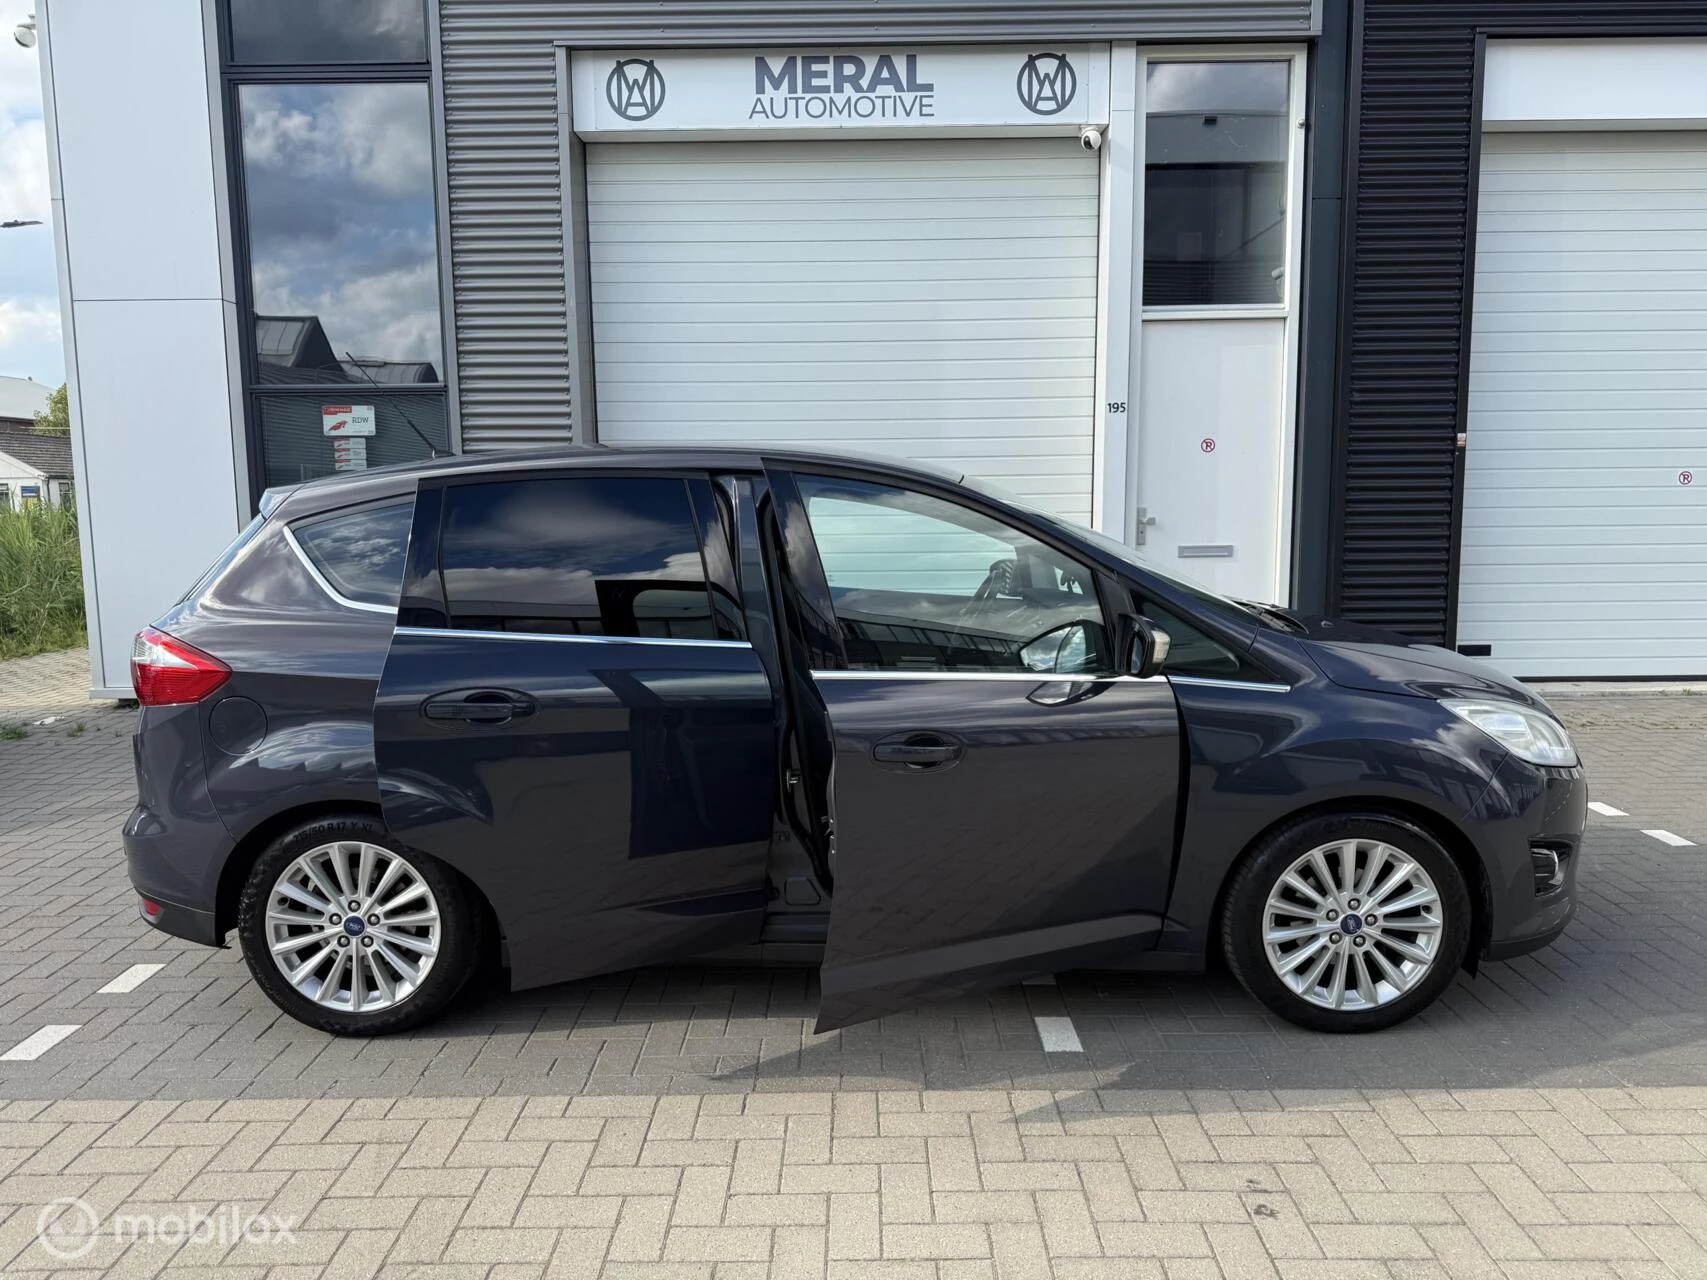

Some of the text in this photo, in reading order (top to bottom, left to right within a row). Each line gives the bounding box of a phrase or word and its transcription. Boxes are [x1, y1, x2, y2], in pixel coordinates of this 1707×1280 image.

[755, 54, 935, 95] MERAL
[749, 95, 935, 119] AUTOMOTIVE
[1107, 402, 1126, 413] 195
